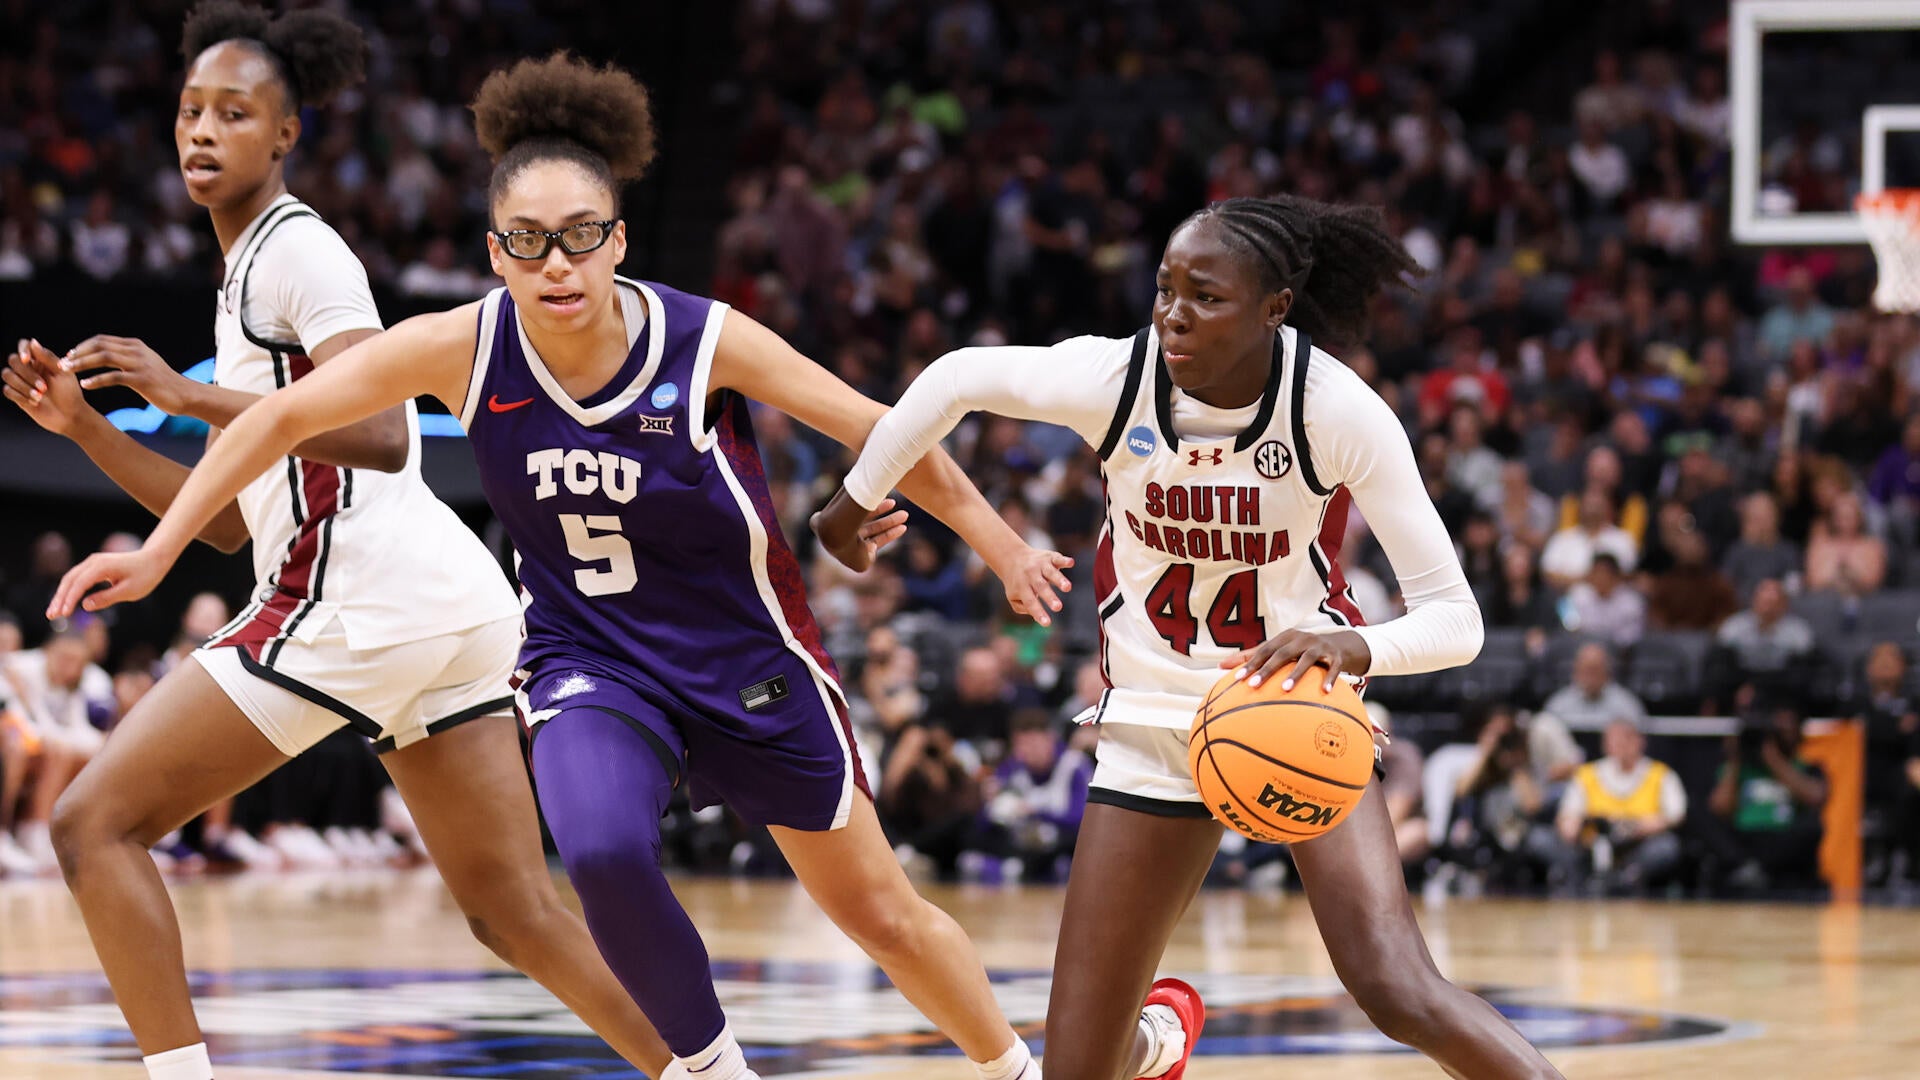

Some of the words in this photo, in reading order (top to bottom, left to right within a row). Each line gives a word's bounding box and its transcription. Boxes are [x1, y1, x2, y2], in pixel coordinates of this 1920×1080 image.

[642, 417, 672, 432] XII
[1130, 437, 1153, 452] NCAA
[527, 448, 641, 504] TCU
[1256, 442, 1290, 478] SEC
[1145, 481, 1260, 525] SOUTH
[558, 513, 638, 597] 5
[1125, 510, 1290, 566] CAROLINA
[1145, 562, 1267, 657] 44
[774, 684, 781, 693] L
[1257, 782, 1342, 826] NCAA
